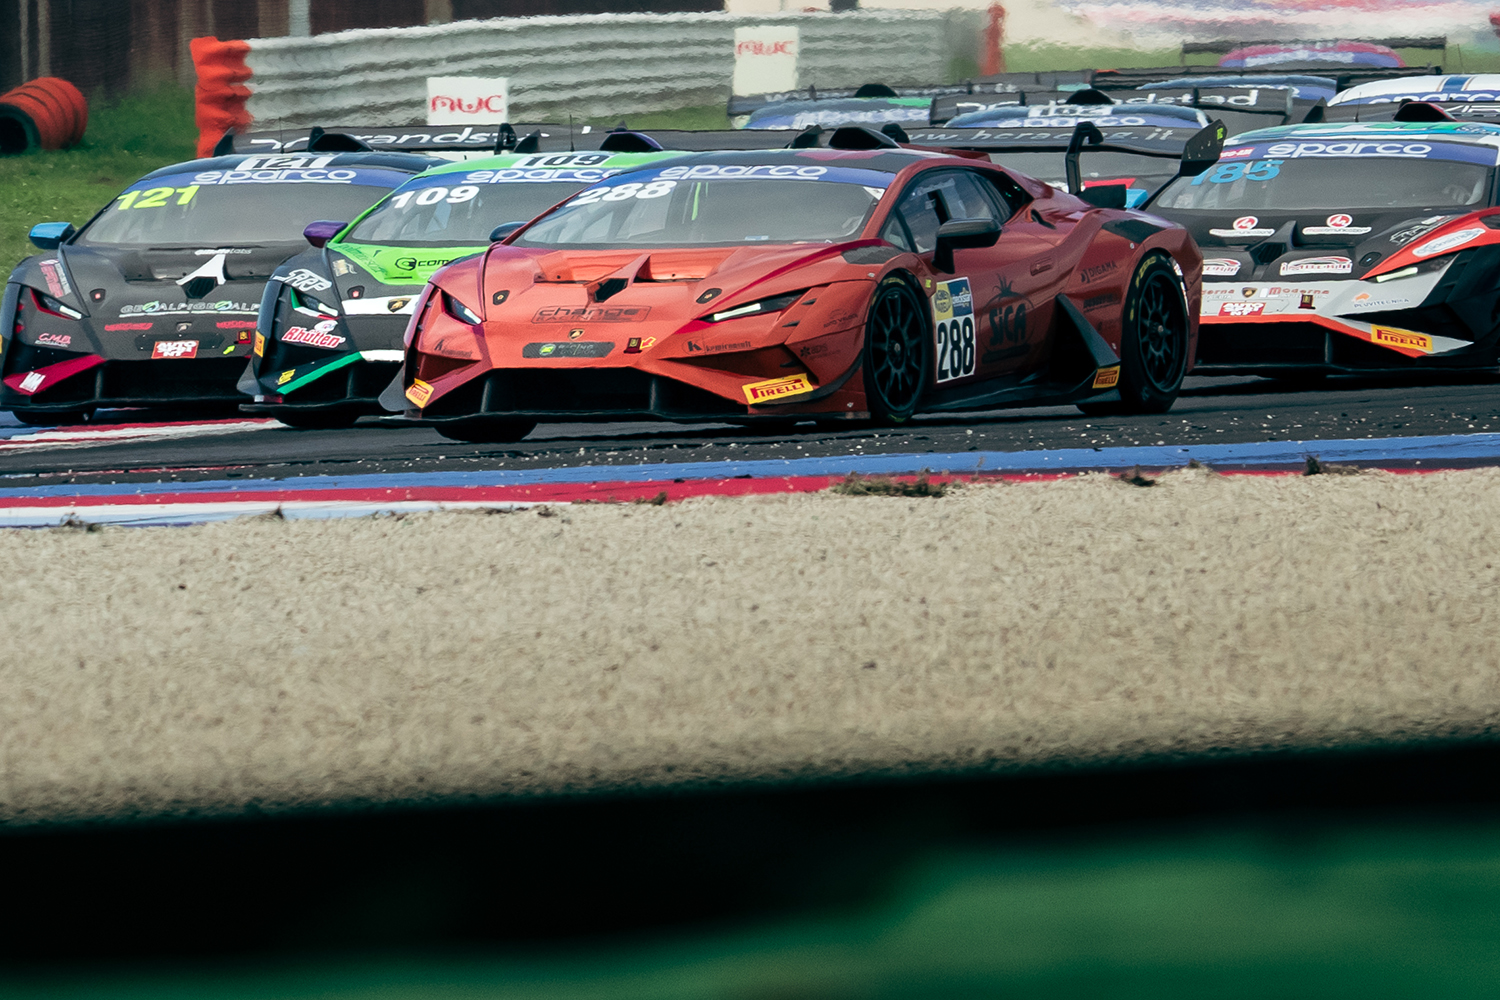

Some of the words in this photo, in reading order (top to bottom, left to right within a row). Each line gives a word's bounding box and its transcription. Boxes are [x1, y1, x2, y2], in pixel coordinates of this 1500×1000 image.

[1267, 142, 1432, 158] sparco
[193, 169, 357, 185] sparco
[655, 164, 828, 181] sparco
[1190, 159, 1286, 186] 185
[118, 184, 200, 211] 121
[391, 185, 480, 209] 109
[565, 180, 678, 208] 288
[937, 317, 975, 380] 288
[1376, 329, 1428, 348] PIRELLI
[749, 378, 805, 400] PIRELLI
